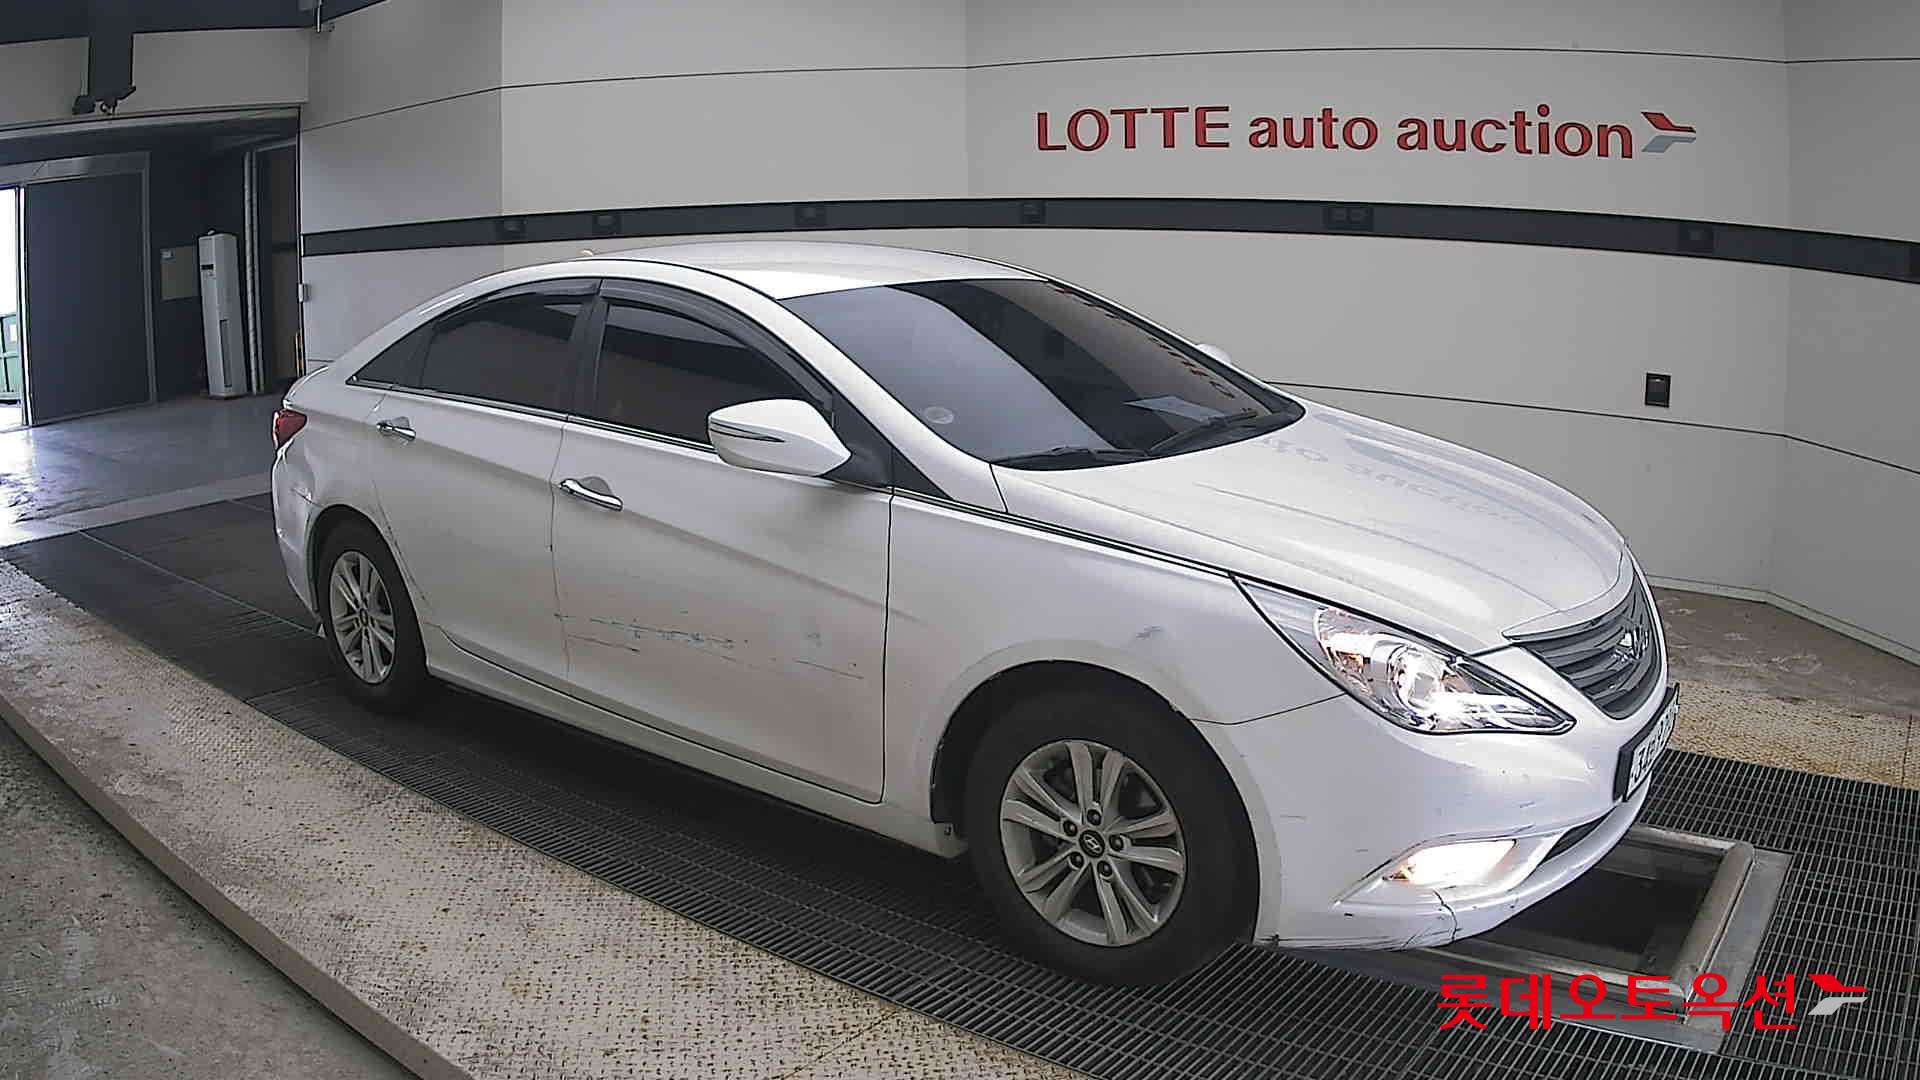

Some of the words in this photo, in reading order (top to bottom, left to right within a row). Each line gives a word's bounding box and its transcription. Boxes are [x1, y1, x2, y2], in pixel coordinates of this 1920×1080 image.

[1037, 105, 1230, 152] LOTTE
[1248, 107, 1379, 150] auto
[1396, 104, 1634, 159] auction
